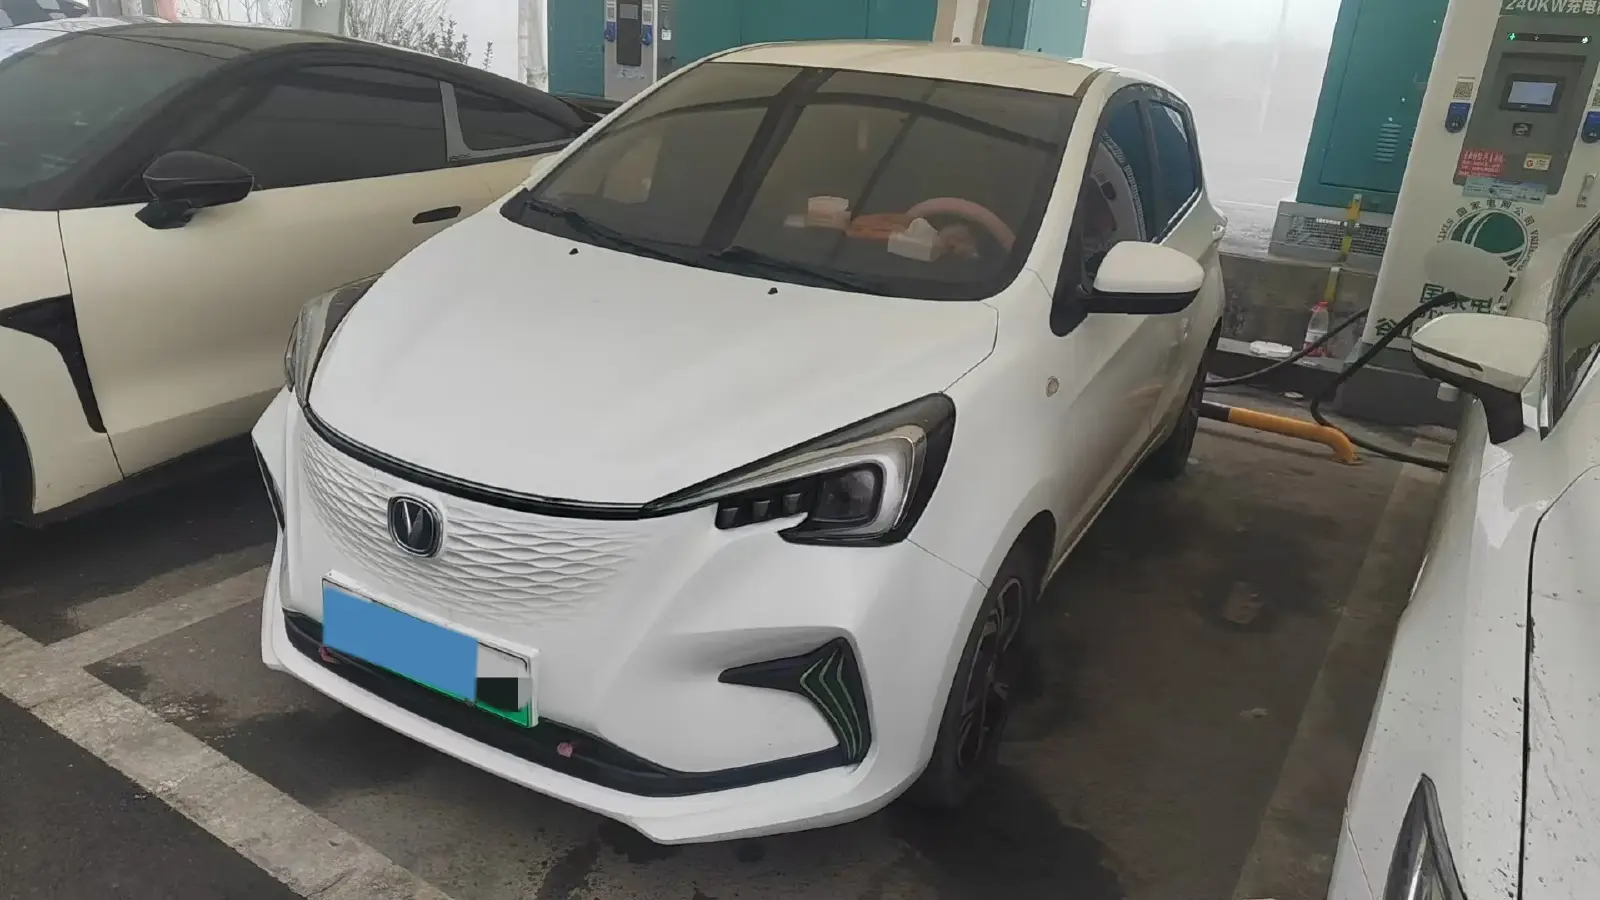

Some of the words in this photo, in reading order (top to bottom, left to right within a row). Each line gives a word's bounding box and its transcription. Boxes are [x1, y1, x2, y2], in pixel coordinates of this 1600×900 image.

[1456, 199, 1535, 226] 国家电网公司
